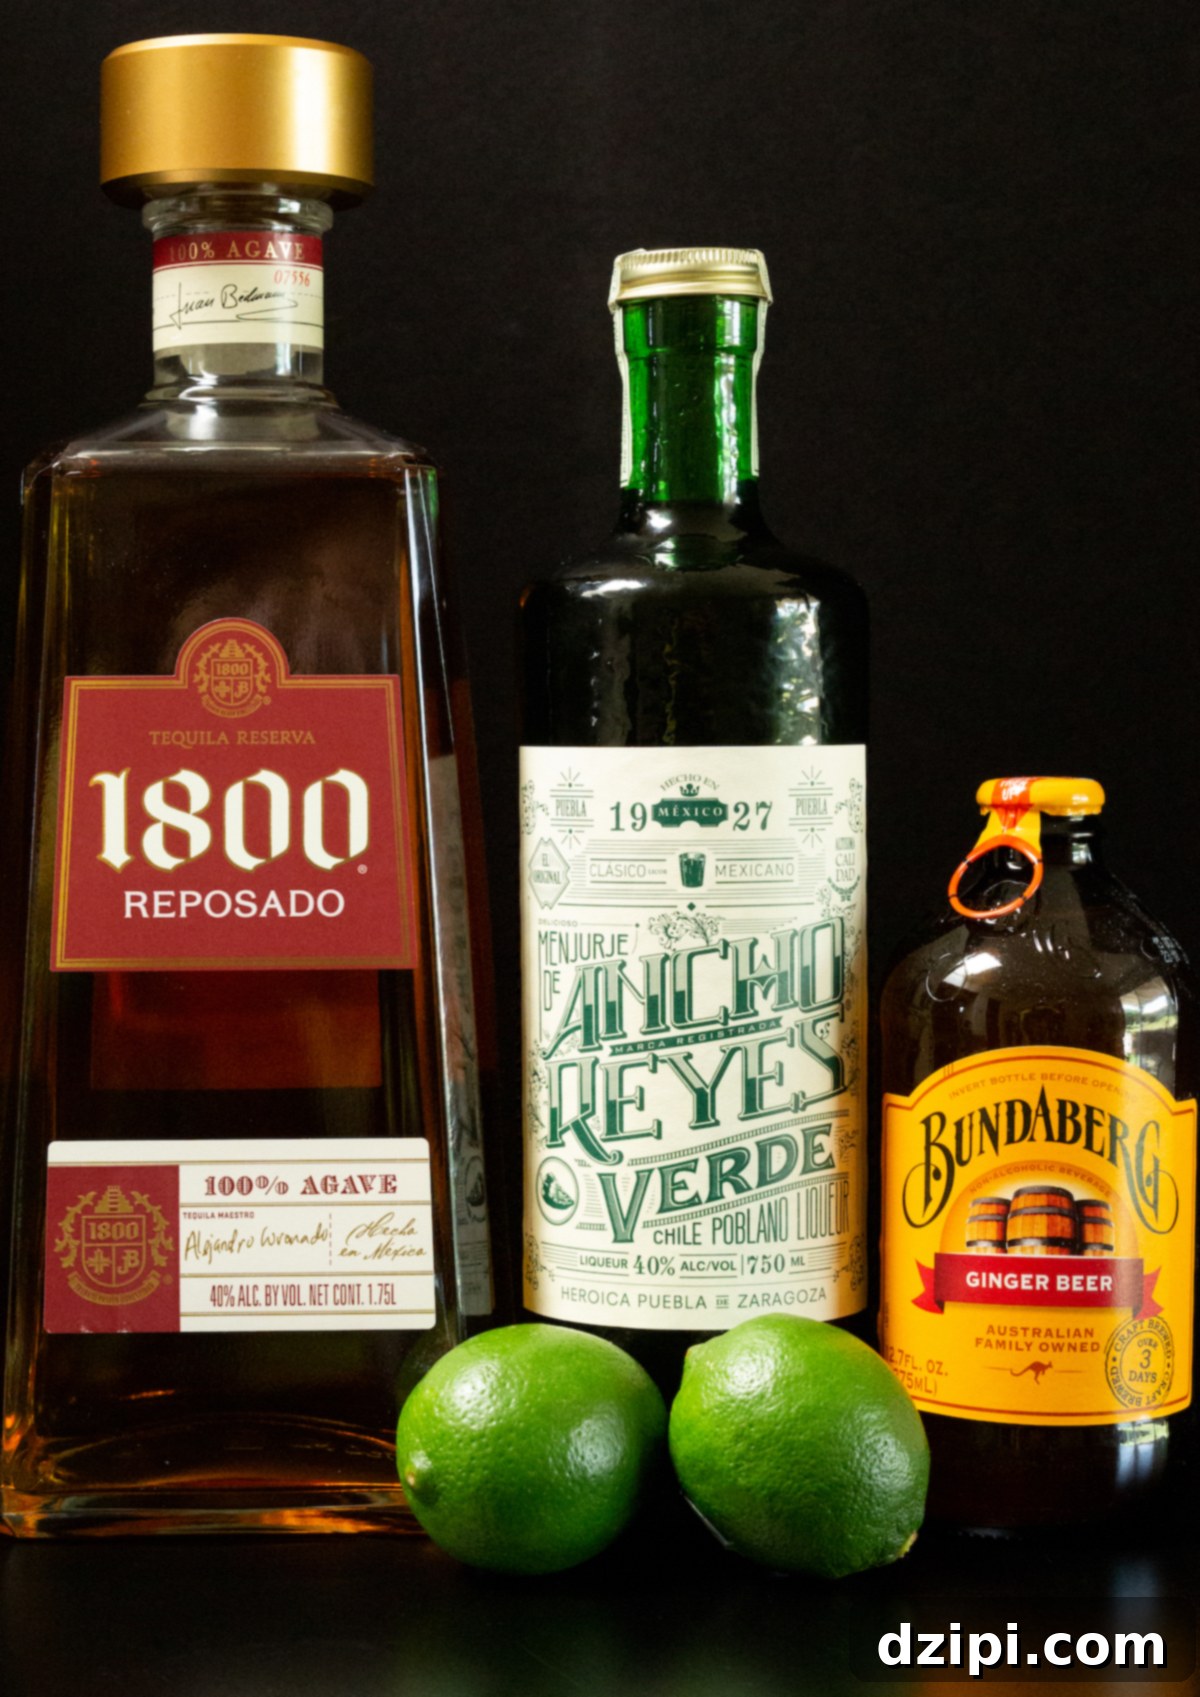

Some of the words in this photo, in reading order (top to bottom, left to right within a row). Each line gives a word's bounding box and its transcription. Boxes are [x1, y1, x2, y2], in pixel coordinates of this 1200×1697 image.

[168, 241, 215, 262] 100%
[226, 239, 305, 261] AGAVE
[215, 662, 250, 676] 1800
[149, 730, 230, 749] TEQUILA
[236, 730, 317, 746] RESERVA
[659, 773, 702, 792] HECHO
[703, 776, 720, 791] EN
[555, 799, 587, 817] PUEBLA
[609, 801, 648, 832] 19
[657, 805, 724, 817] MÉXICO
[732, 801, 773, 832] 27
[795, 797, 829, 816] PUEBLA
[88, 766, 370, 874] 1800
[589, 861, 647, 879] CLÁSICO
[714, 863, 796, 878] MEXICANO
[123, 889, 345, 919] REPOSADO
[537, 930, 629, 966] MENJURJE
[540, 916, 845, 1061] ANCHO
[542, 969, 562, 1012] DE
[614, 1040, 667, 1056] MARCA
[676, 1020, 778, 1046] REGISTRADA
[543, 1004, 850, 1167] REYES
[949, 1079, 987, 1099] INVERT
[989, 1072, 1037, 1086] BOTTLE
[1040, 1072, 1089, 1085] BEFORE
[902, 1083, 1179, 1236] BUNDABERG
[204, 1175, 290, 1197] 100%
[299, 1174, 398, 1196] AGAVE
[597, 1122, 837, 1244] VERDE
[969, 1163, 1056, 1194] NON-ALCOHOLIC
[1058, 1167, 1113, 1199] BEVERAGE
[182, 1212, 216, 1220] TEQUILA
[217, 1211, 255, 1219] MAESTRO
[653, 1222, 703, 1246] CHILE
[711, 1196, 789, 1246] POBLANO
[796, 1180, 850, 1241] LIQUEUR
[88, 1221, 139, 1241] 1800
[579, 1254, 629, 1270] LIQUEUR
[632, 1254, 676, 1277] 40%
[680, 1260, 738, 1273] ALC/VOL
[746, 1253, 786, 1275] 750
[790, 1256, 806, 1267] ML
[965, 1270, 1050, 1291] GINGER
[1056, 1274, 1114, 1292] BEER
[209, 1284, 236, 1308] 40%
[237, 1284, 262, 1307] ALC.
[264, 1284, 279, 1307] BY
[280, 1284, 306, 1307] VOL.
[309, 1283, 330, 1306] NET
[332, 1283, 364, 1306] CONT.
[367, 1282, 397, 1306] 1.75L
[560, 1286, 631, 1308] HEROICA
[637, 1293, 708, 1310] PUEBLA
[716, 1298, 730, 1307] DE
[737, 1286, 828, 1309] ZARAGOZA
[986, 1324, 1095, 1339] AUSTRALIAN
[1114, 1320, 1145, 1353] CRAFT
[974, 1337, 1034, 1352] FAMILY
[1038, 1340, 1101, 1353] OWNED
[1136, 1337, 1159, 1350] OVER
[925, 1359, 949, 1377] OZ.
[1139, 1349, 1152, 1370] 3
[1128, 1370, 1158, 1384] DAYS
